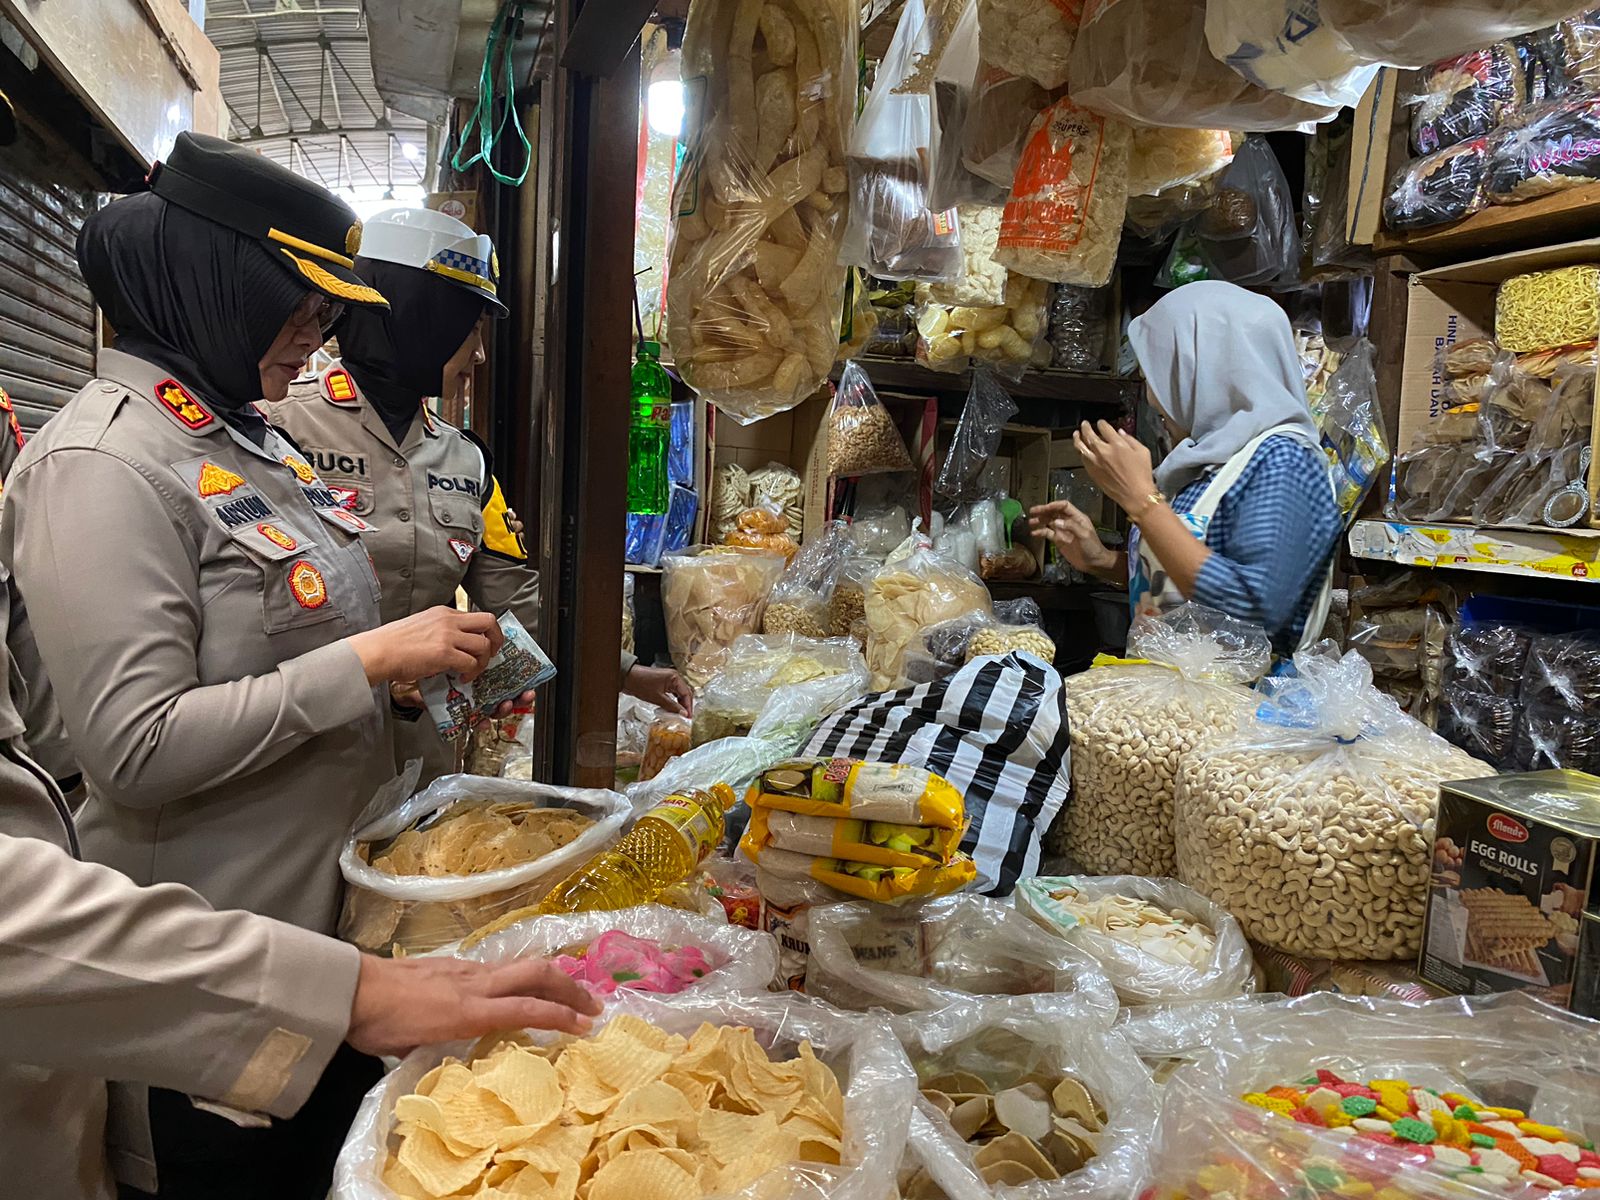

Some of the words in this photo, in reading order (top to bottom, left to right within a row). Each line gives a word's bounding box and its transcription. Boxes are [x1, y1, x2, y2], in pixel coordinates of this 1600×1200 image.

[427, 473, 480, 497] POLRI
[1492, 819, 1524, 838] Monde
[1470, 840, 1497, 860] EGG
[1499, 850, 1538, 876] ROLLS
